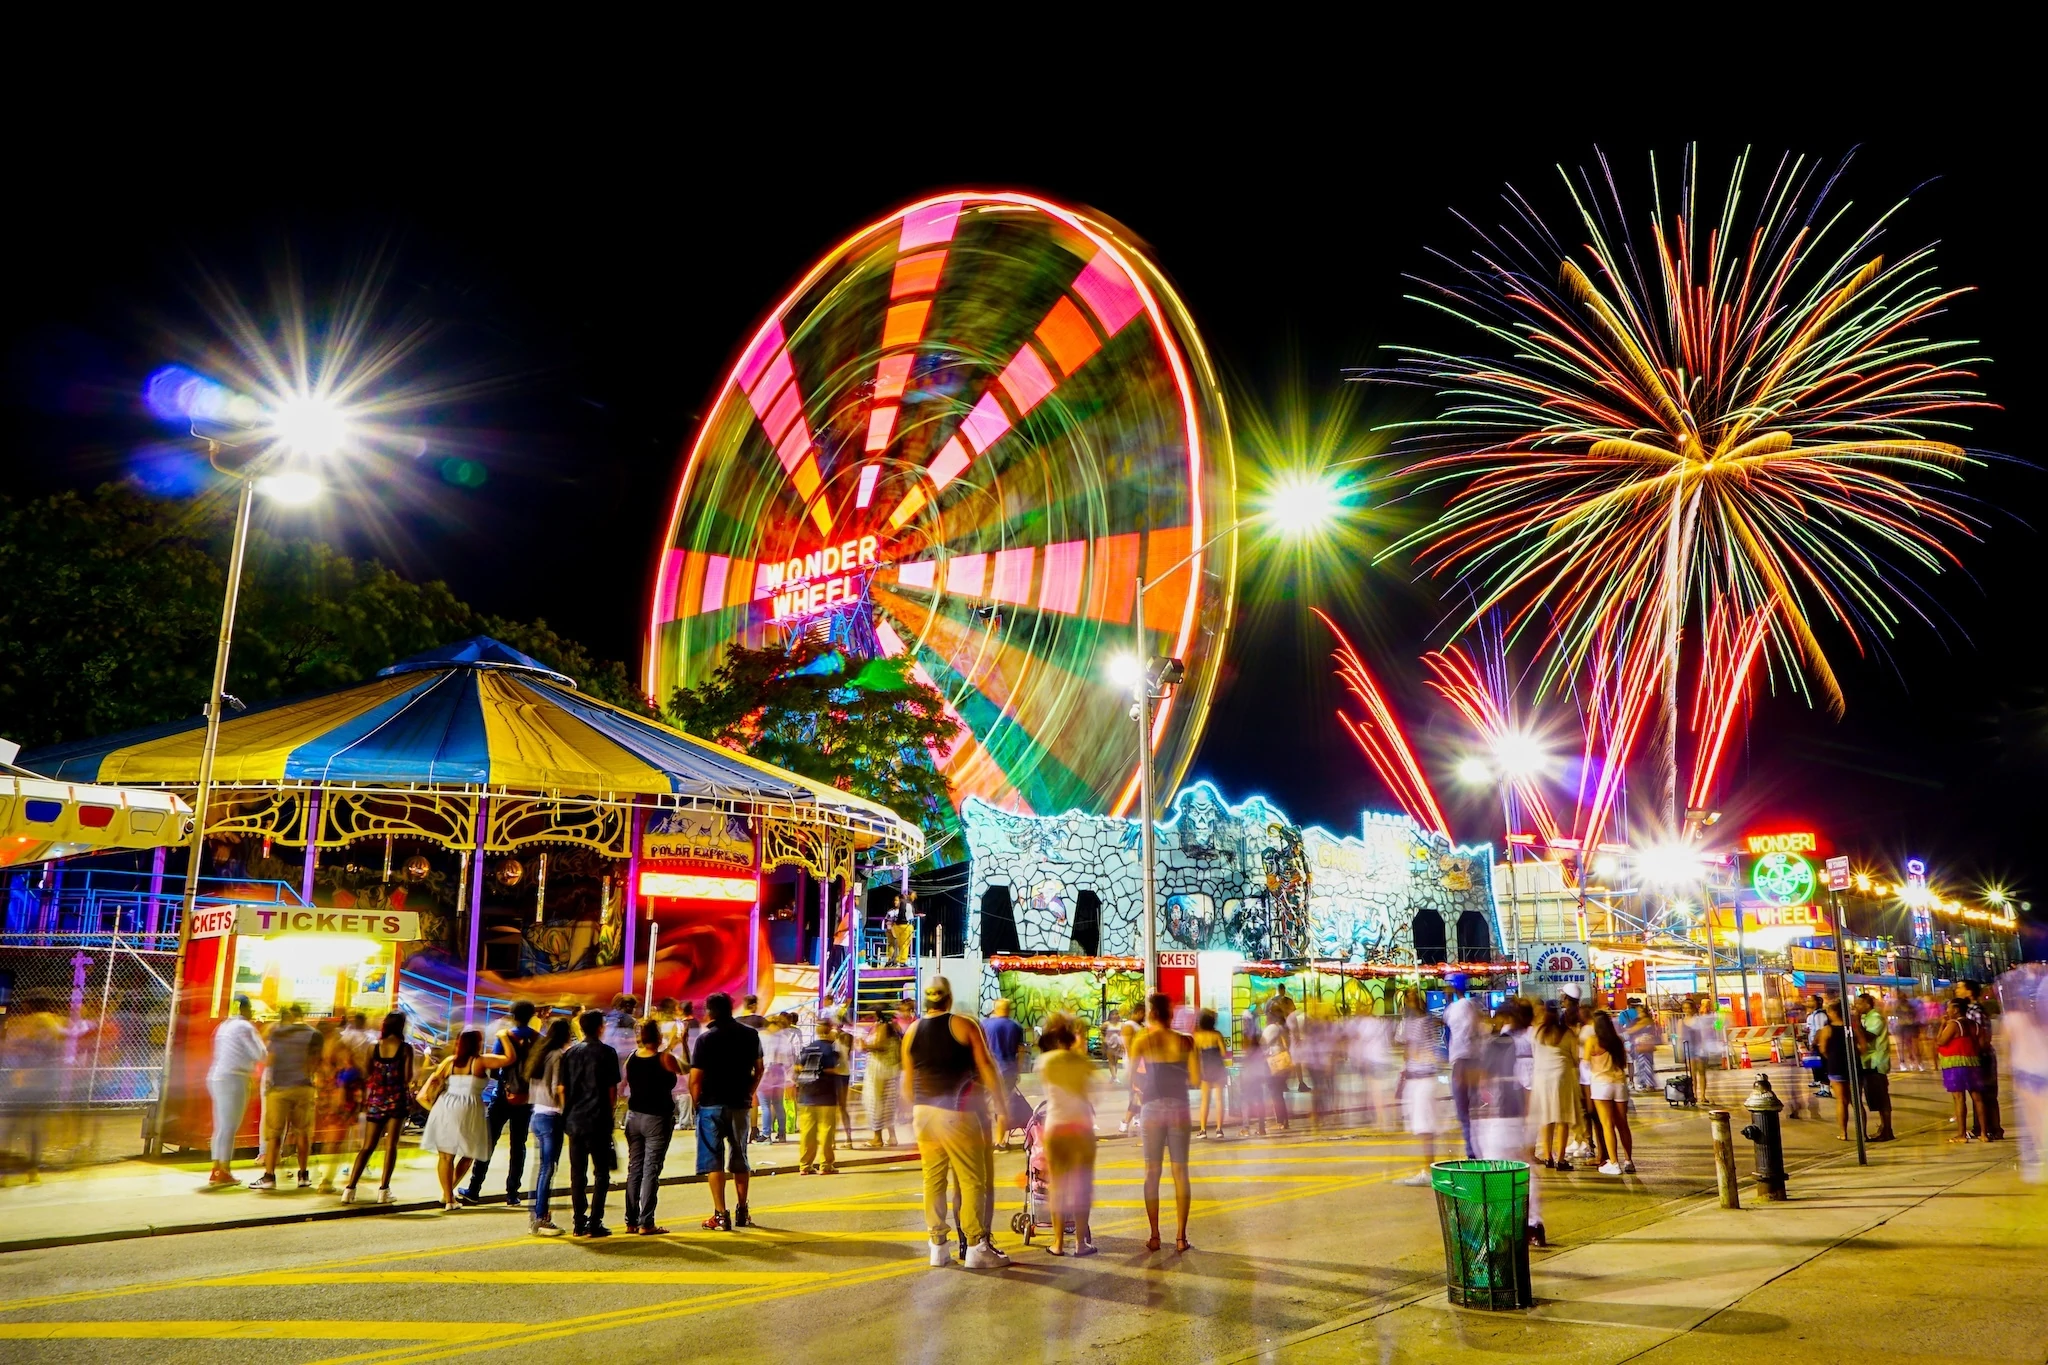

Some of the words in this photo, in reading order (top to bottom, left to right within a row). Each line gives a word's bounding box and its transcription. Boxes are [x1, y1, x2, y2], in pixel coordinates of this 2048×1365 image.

[766, 535, 877, 591] WONDER
[773, 576, 859, 620] WHEEL
[1748, 833, 1812, 853] WONDER
[651, 845, 691, 857] POLAR
[693, 845, 750, 866] EXPRESS
[192, 910, 231, 934] CKETS
[257, 910, 400, 934] TICKETS
[1757, 905, 1817, 925] WHEEL
[1157, 953, 1196, 966] ICKETS
[1535, 946, 1559, 972] VIRTUAL
[1560, 946, 1587, 970] REALITY
[1548, 956, 1573, 972] 3D
[1538, 974, 1585, 982] SMULATOR
